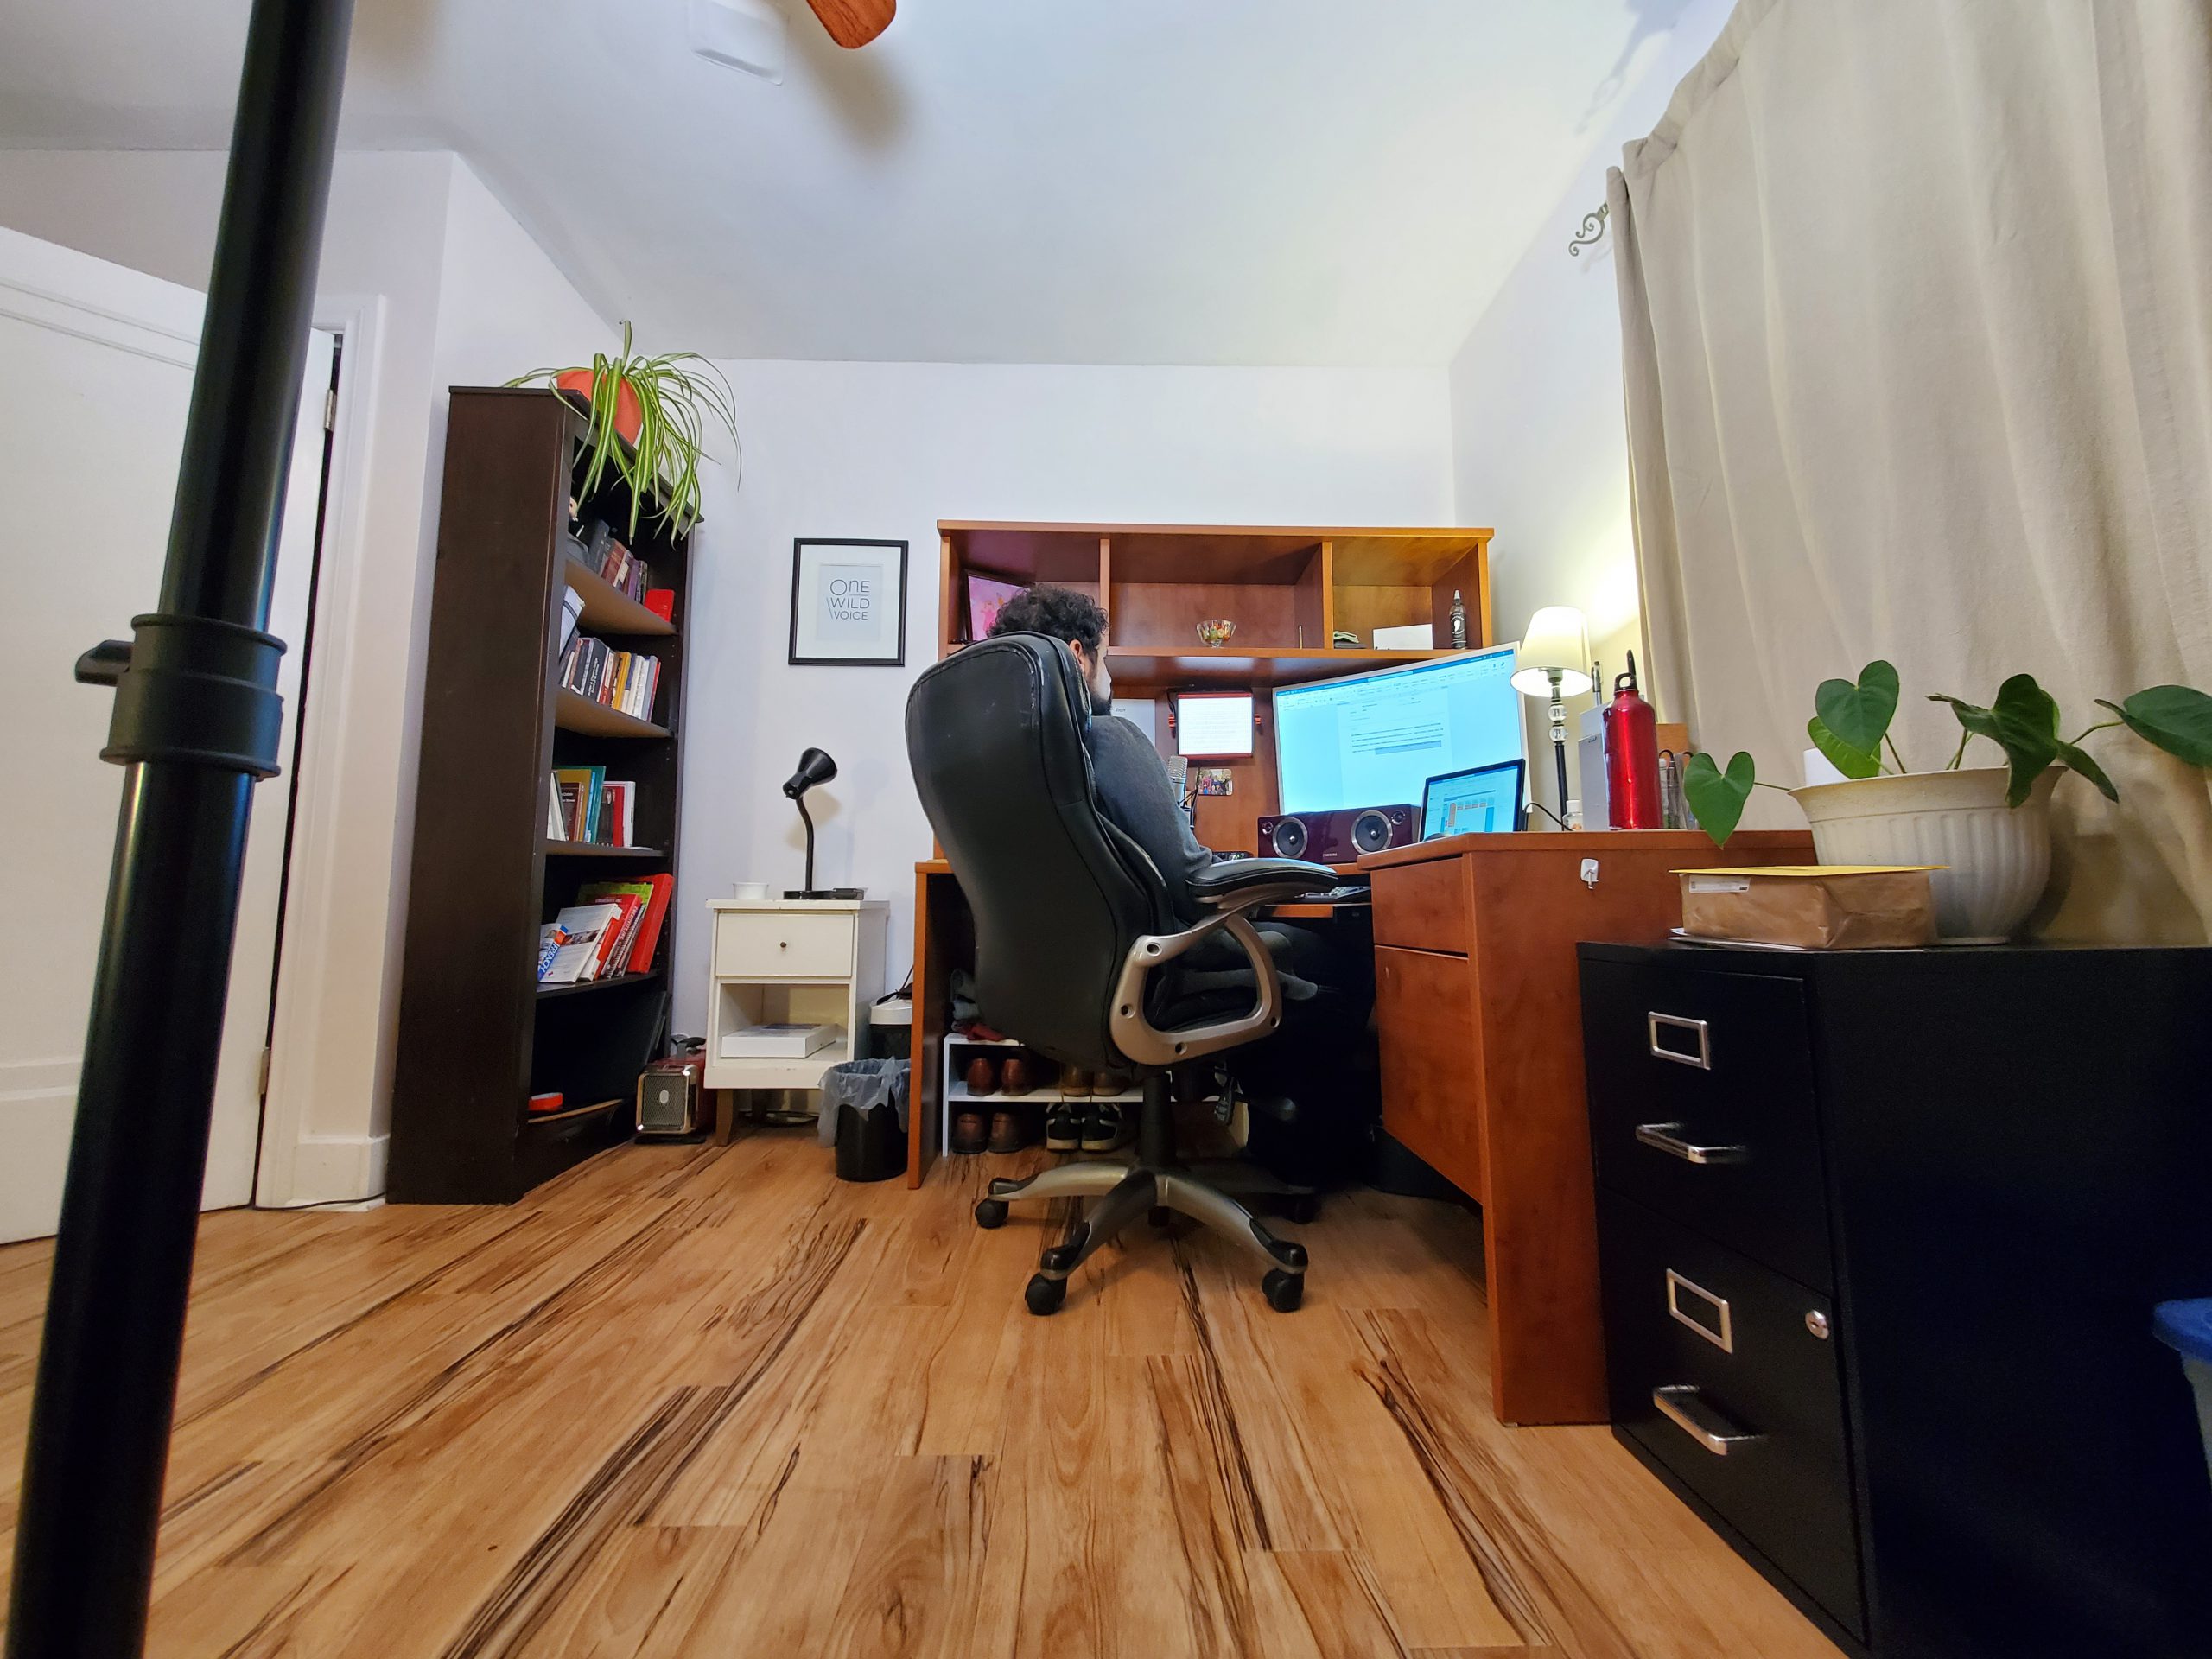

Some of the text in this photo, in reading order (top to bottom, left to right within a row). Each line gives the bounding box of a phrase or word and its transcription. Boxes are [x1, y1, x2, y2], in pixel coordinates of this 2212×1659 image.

[830, 597, 870, 609] WILD
[834, 610, 868, 620] VOICE
[540, 943, 559, 973] FRENCH
